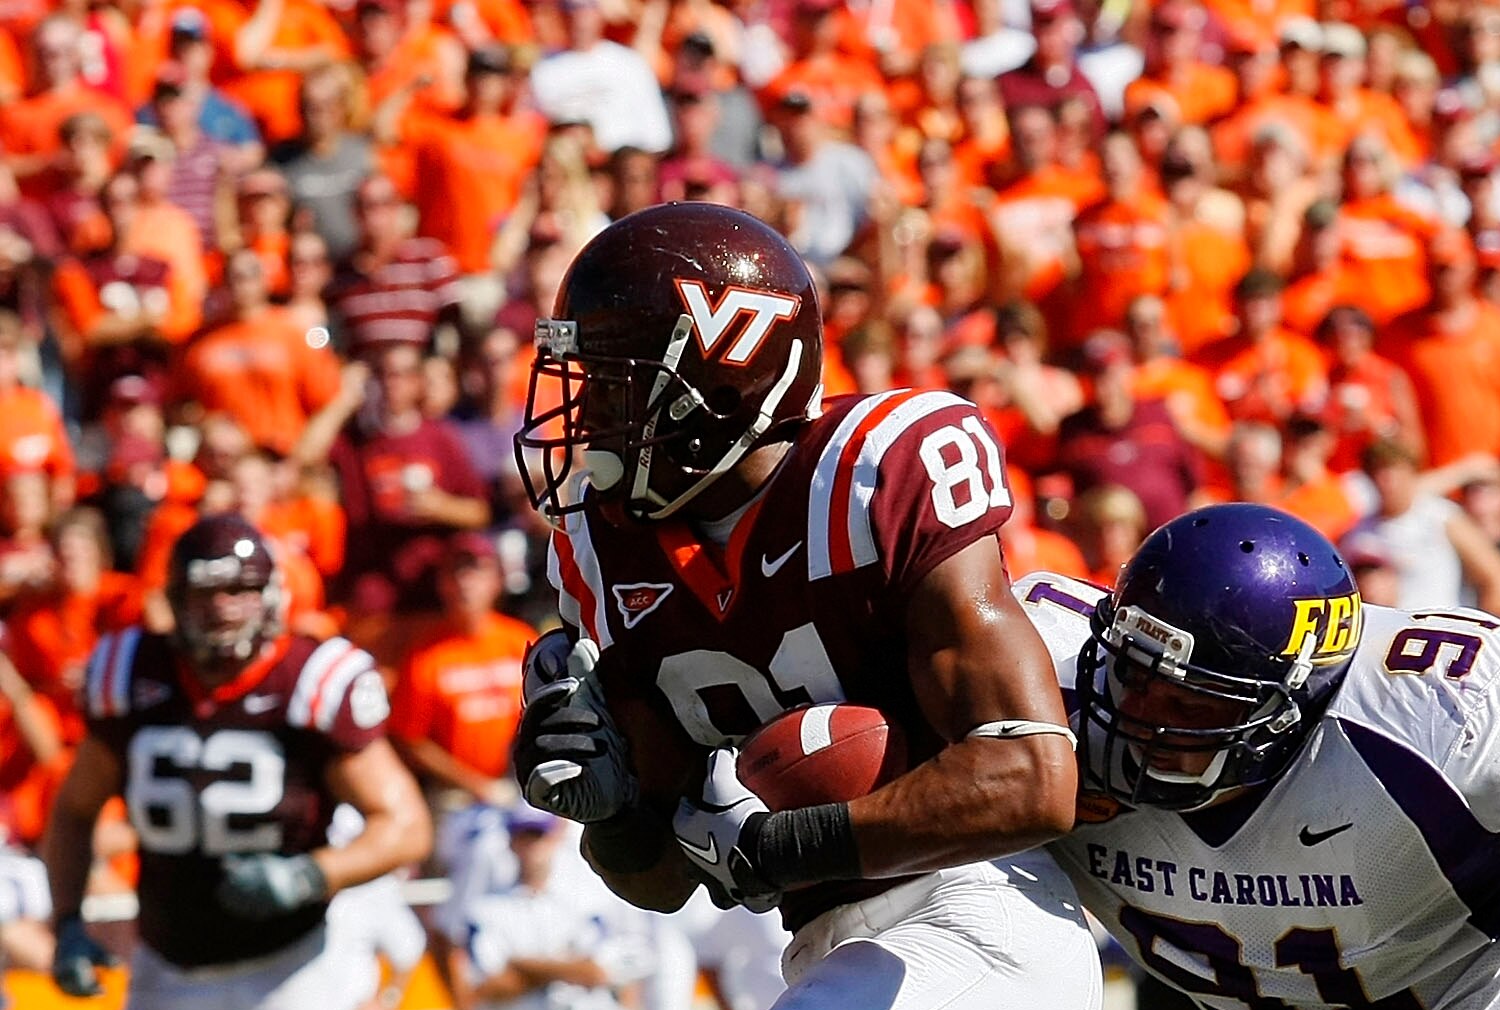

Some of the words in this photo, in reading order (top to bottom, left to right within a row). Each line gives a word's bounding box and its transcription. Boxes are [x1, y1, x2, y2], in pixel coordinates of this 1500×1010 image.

[674, 277, 802, 367] VT
[918, 415, 1012, 528] 81
[128, 725, 286, 855] 62
[1087, 843, 1177, 897] EAST
[1188, 866, 1364, 907] CAROLINA
